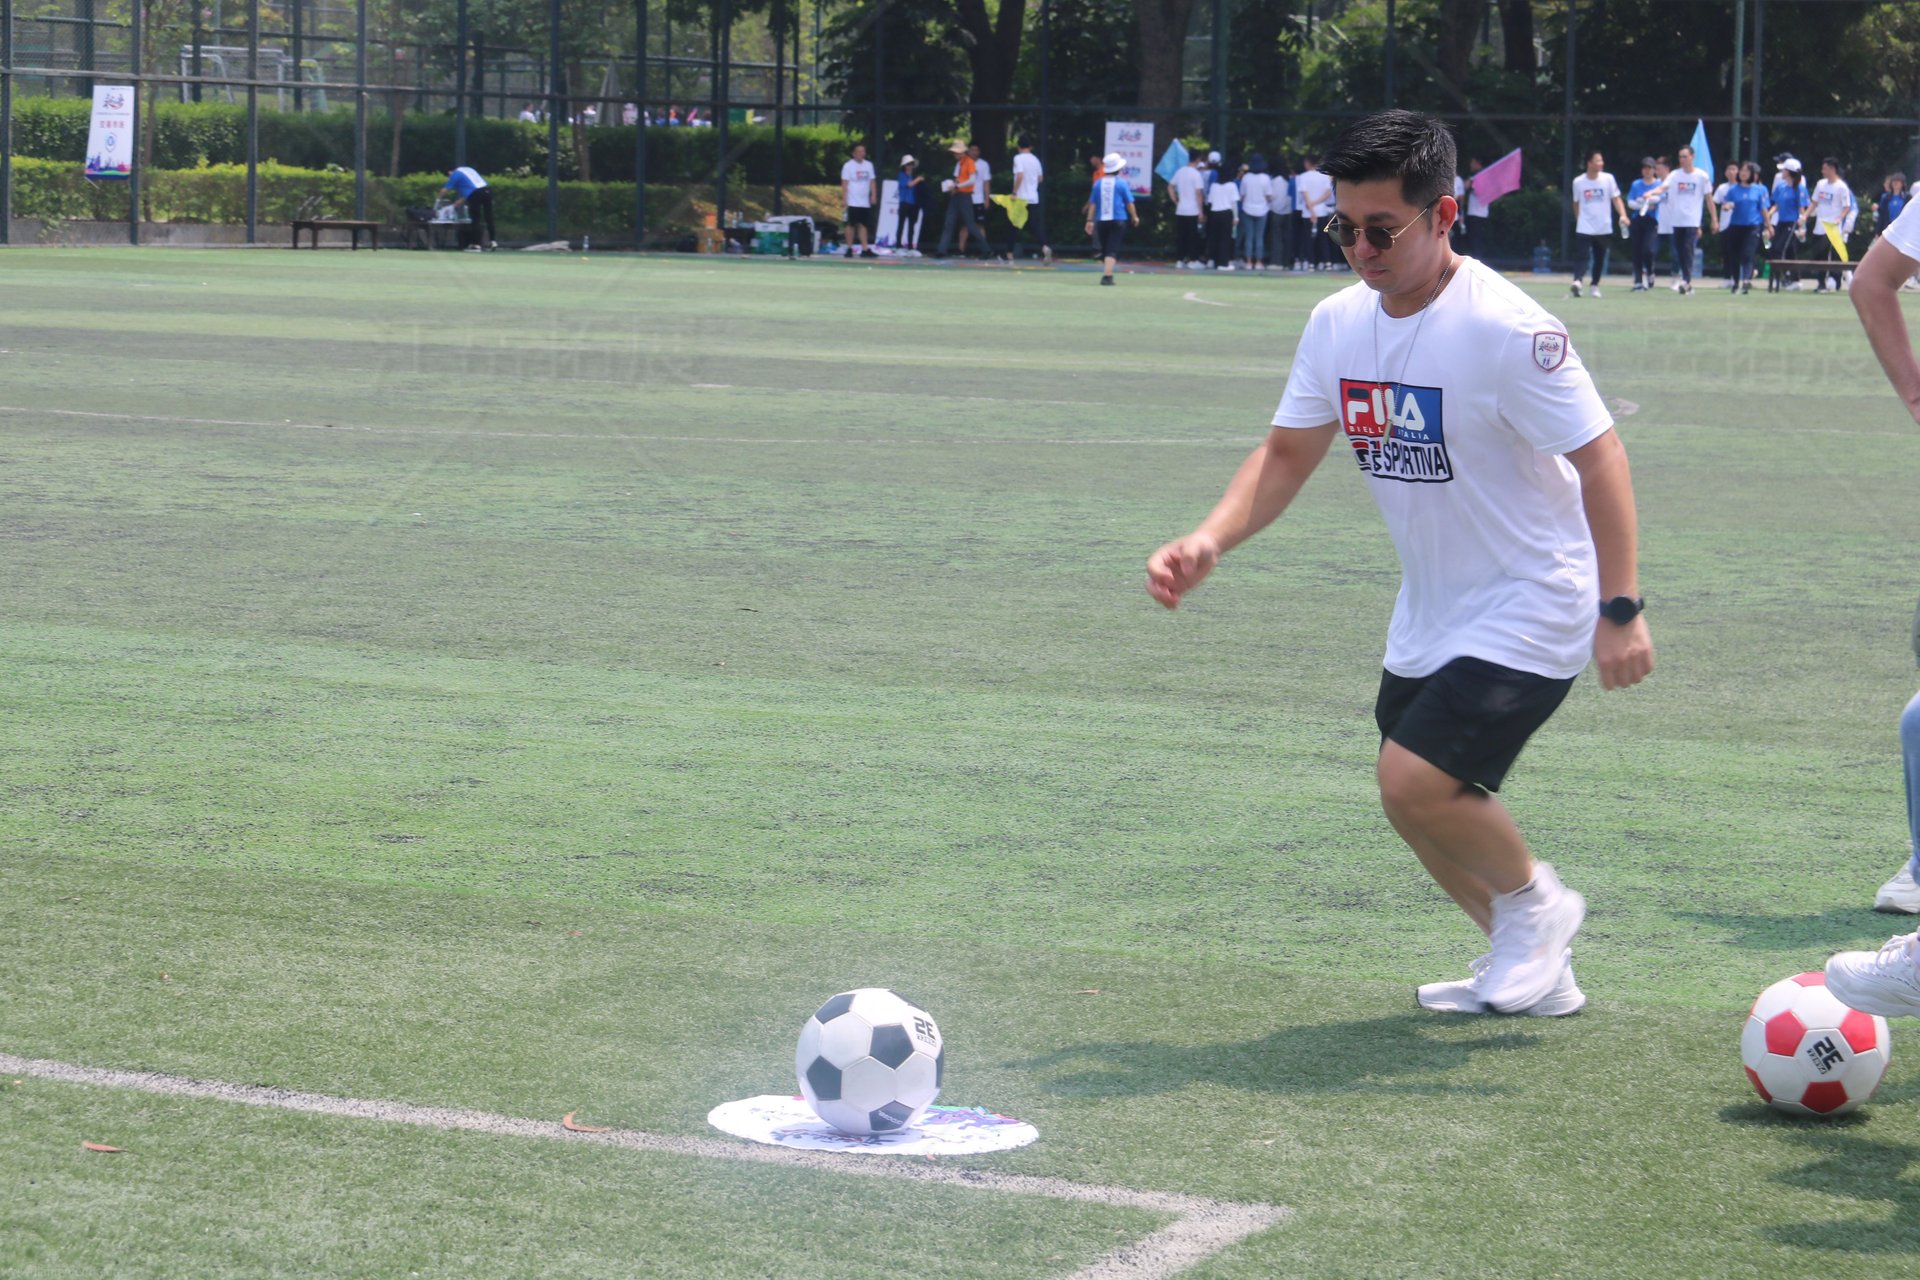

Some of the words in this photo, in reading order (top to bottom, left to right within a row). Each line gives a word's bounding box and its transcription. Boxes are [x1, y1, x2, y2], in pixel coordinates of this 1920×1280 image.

[1347, 388, 1425, 431] FILA
[1348, 426, 1384, 434] BIELL
[1398, 428, 1430, 440] ITALIA
[913, 1015, 936, 1040] 2E
[1813, 1036, 1844, 1071] 2E
